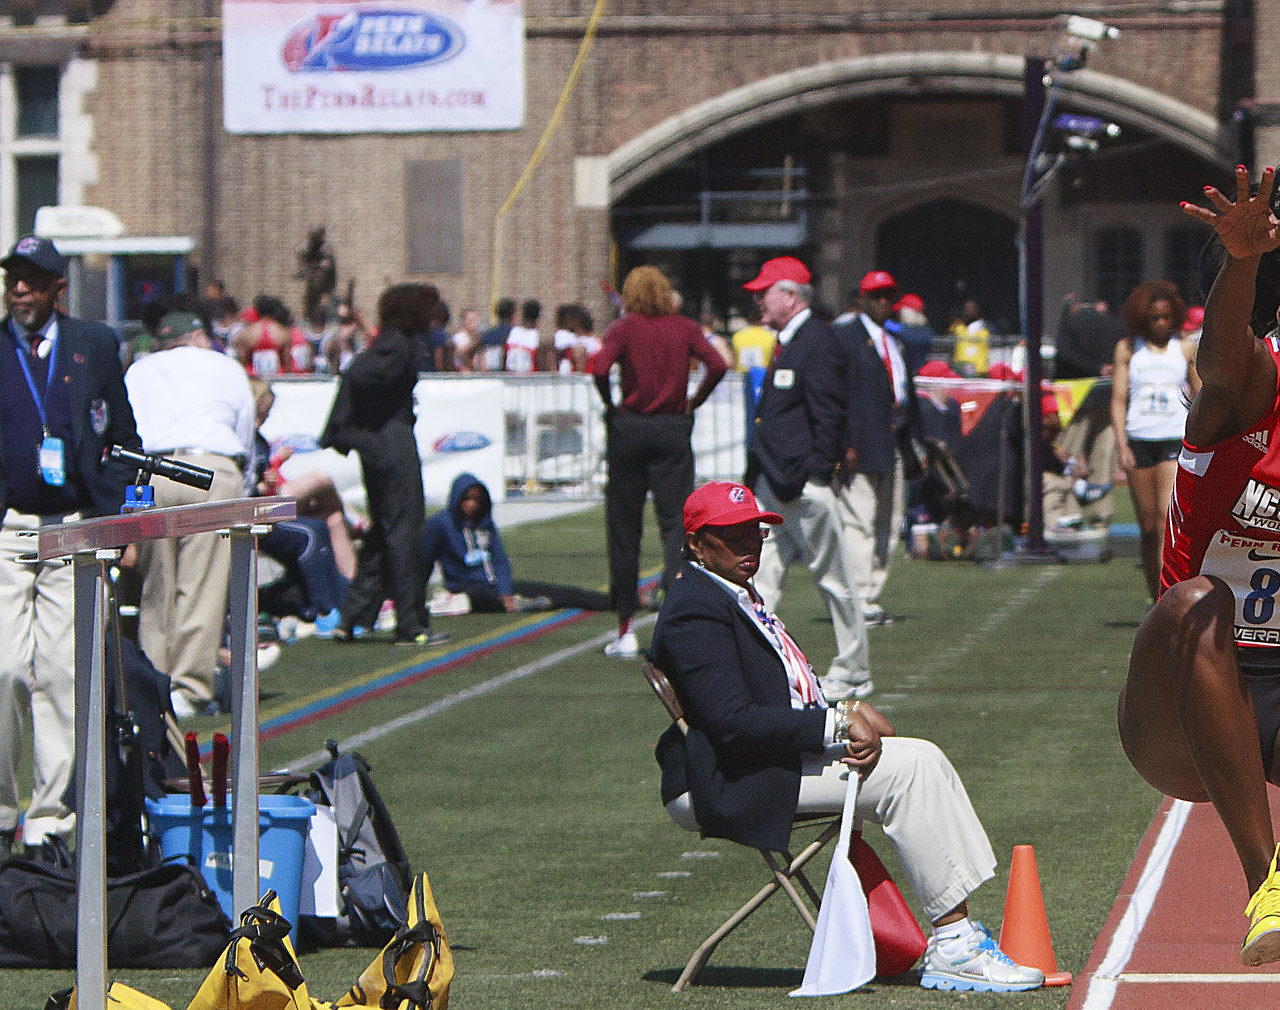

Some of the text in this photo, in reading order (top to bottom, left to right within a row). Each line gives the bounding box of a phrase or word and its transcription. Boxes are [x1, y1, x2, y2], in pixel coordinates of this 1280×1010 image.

[360, 16, 425, 33] PENN
[354, 34, 443, 55] RELAYS
[1242, 435, 1269, 454] adidas
[1219, 533, 1265, 549] PENN
